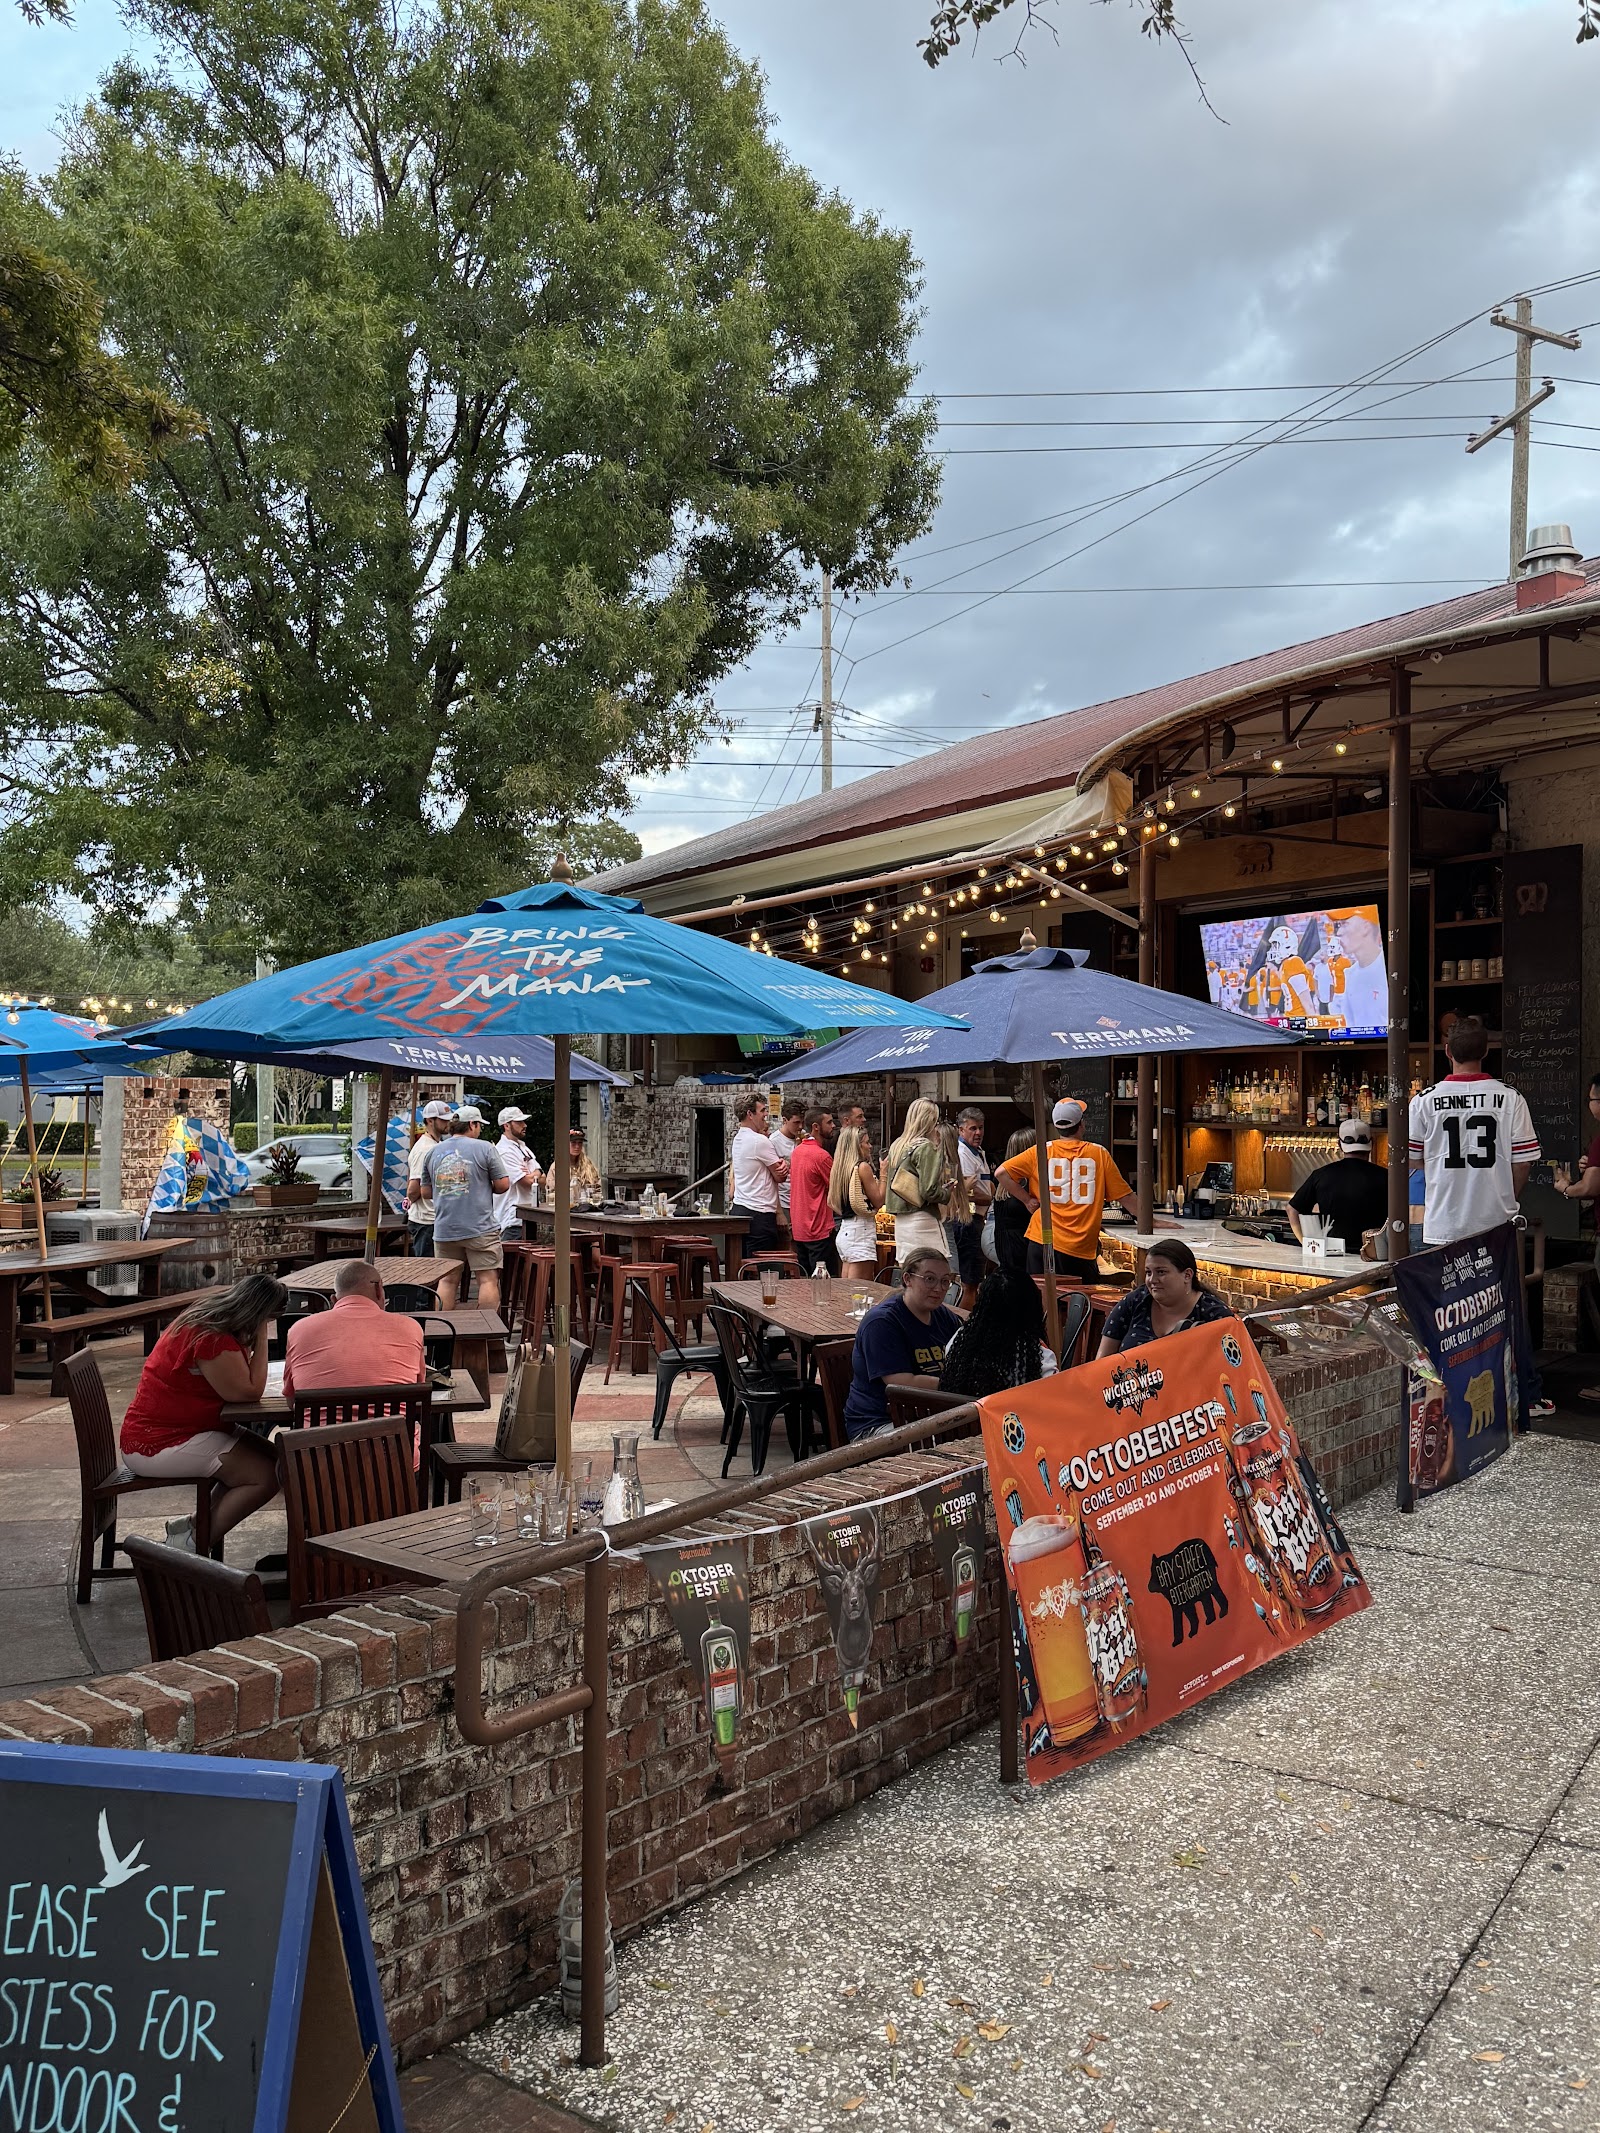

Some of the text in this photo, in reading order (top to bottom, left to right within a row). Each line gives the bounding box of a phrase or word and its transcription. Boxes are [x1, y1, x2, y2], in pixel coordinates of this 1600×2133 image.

[501, 944, 603, 971] THE
[1051, 1024, 1195, 1044] TEREMANA
[1307, 1017, 1318, 1027] 38
[1146, 1036, 1191, 1044] TEQUILA
[389, 1043, 525, 1067] TEREMANA
[866, 1043, 930, 1062] MANA
[405, 1057, 436, 1066] SMALL
[476, 1065, 518, 1074] TEQUILA
[1434, 1094, 1504, 1111] BENNETT IV
[1443, 1115, 1497, 1169] 13
[1048, 1158, 1096, 1205] 98
[1440, 1334, 1458, 1353] COME
[1457, 1329, 1471, 1345] OUT
[1472, 1325, 1483, 1339] AND
[1102, 1369, 1163, 1402] WICKED WEED
[1123, 1390, 1150, 1407] BREWING
[1069, 1401, 1218, 1491] OCTOBERFEST
[1082, 1438, 1224, 1515] COME OUT AND CELEBRATE
[935, 1492, 977, 1517] OKTOBER
[1097, 1462, 1220, 1531] SEPTEMBER 20 AND OCTOBER 4
[945, 1509, 967, 1528] FEST
[828, 1525, 861, 1540] OKTOBER
[836, 1537, 853, 1549] FEST
[670, 1563, 735, 1585] OKTOBER
[1156, 1544, 1207, 1587] BAY STREET
[686, 1581, 719, 1599] FEST
[1170, 1569, 1213, 1606] BIERGARTEN
[142, 1885, 225, 1961] SEE
[139, 1989, 224, 2062] FOR
